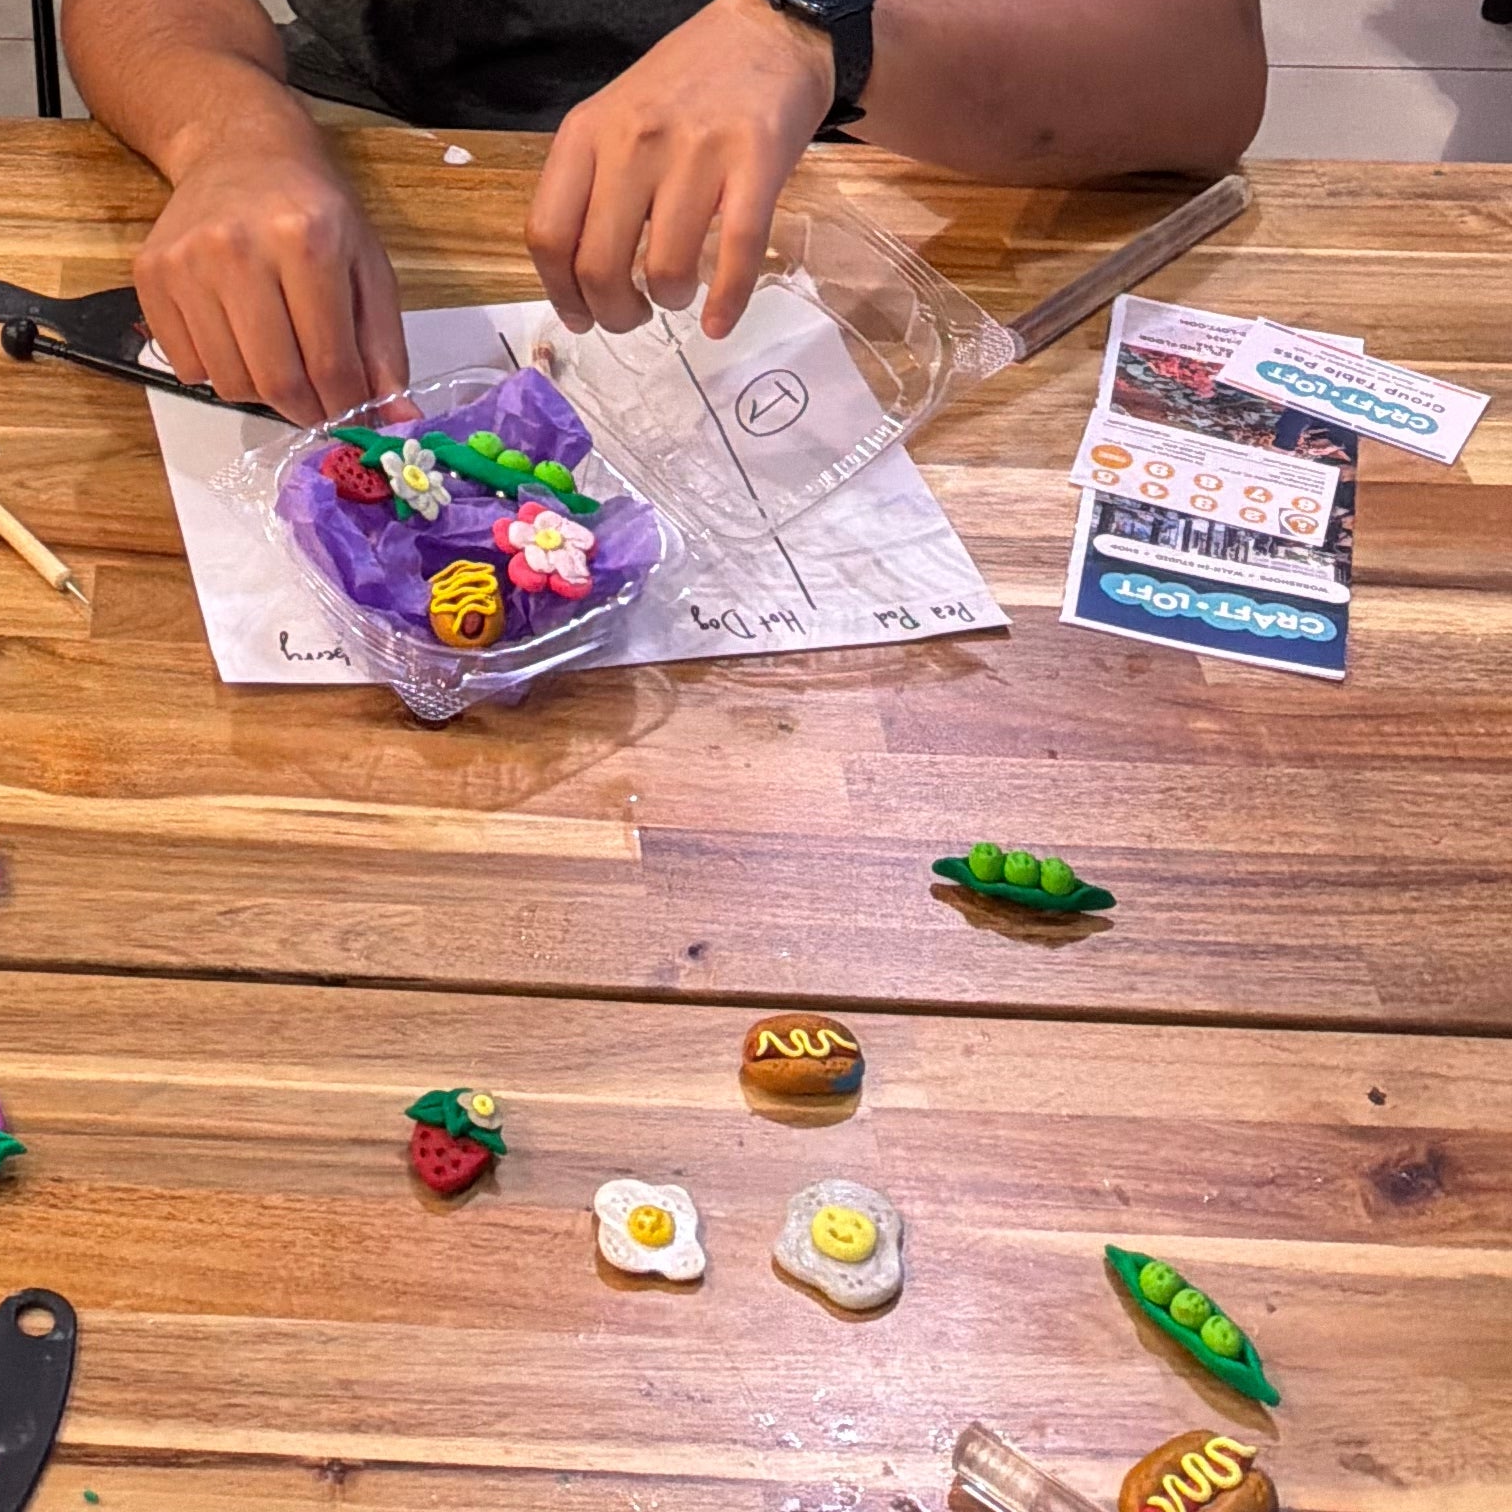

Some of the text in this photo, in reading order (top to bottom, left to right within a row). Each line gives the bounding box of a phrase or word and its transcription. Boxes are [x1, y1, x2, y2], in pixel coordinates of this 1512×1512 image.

[1273, 347, 1319, 370] Pass
[1267, 366, 1329, 399] LOFT
[1324, 366, 1376, 392] Table
[1342, 393, 1430, 430] CRAFT
[1384, 387, 1445, 414] Group
[690, 604, 807, 639] Hot Dog
[873, 601, 976, 630] Pea Pod
[1116, 580, 1325, 635] CRAFT LOFT
